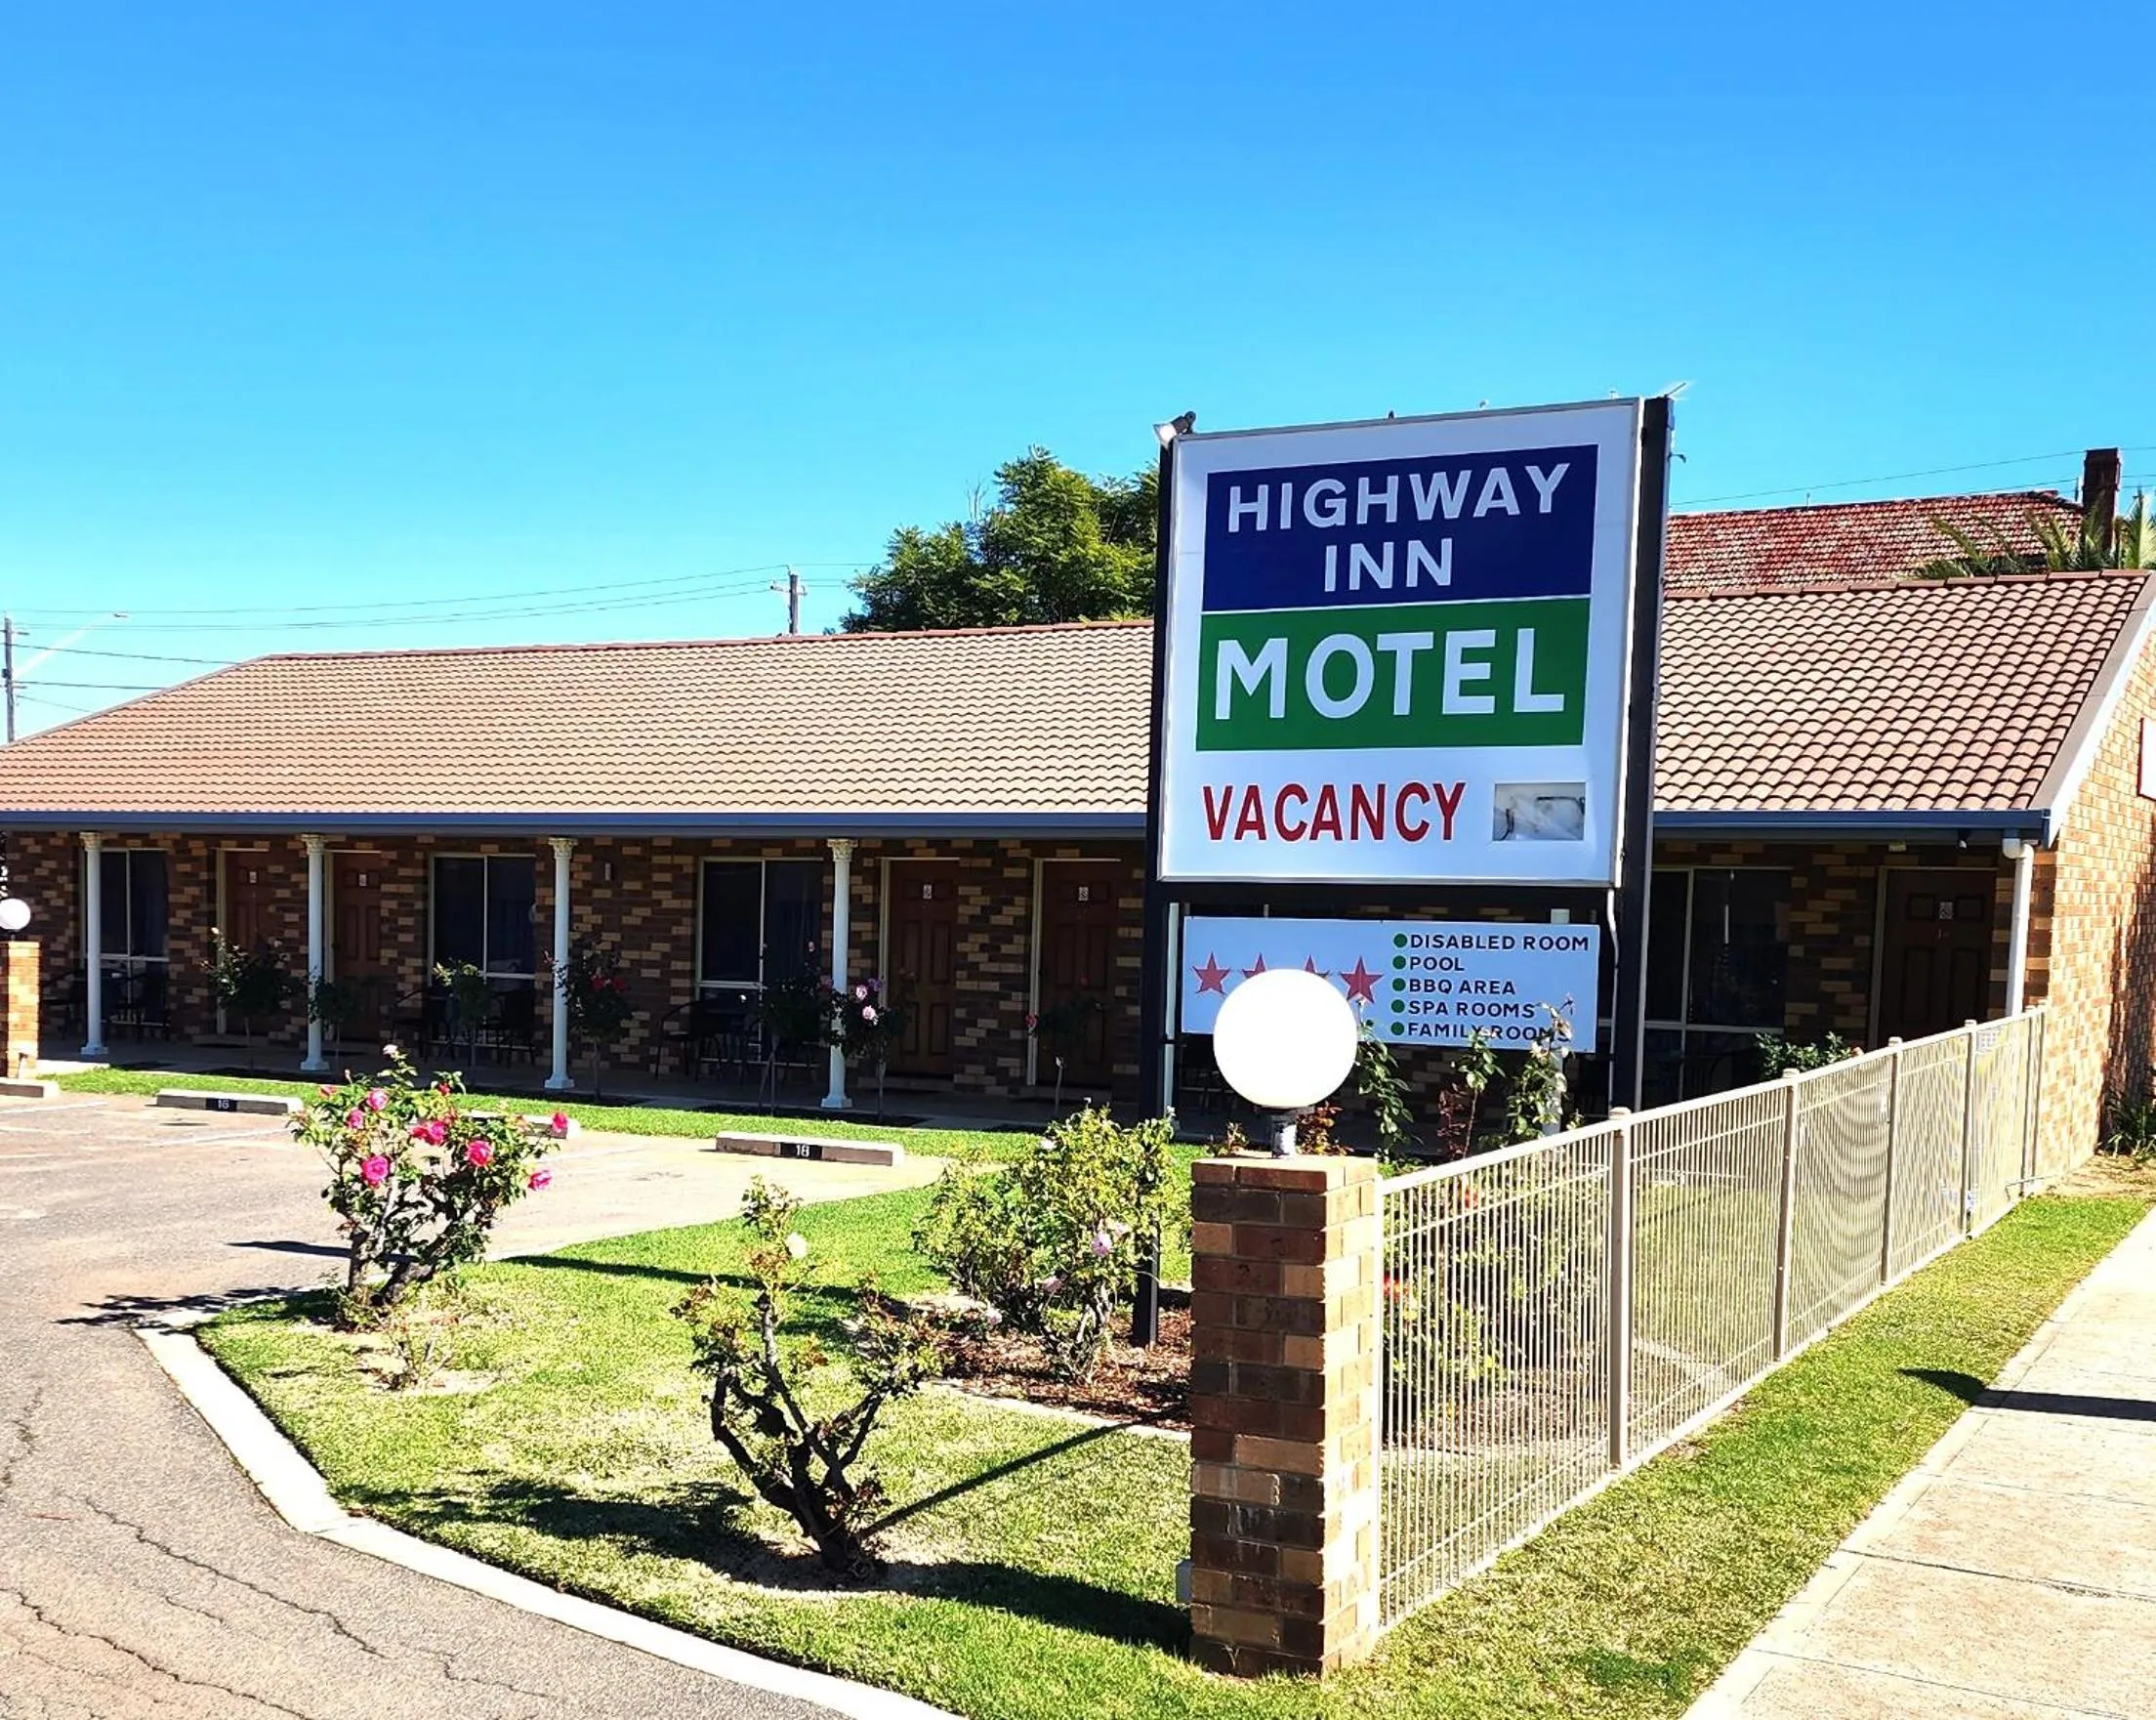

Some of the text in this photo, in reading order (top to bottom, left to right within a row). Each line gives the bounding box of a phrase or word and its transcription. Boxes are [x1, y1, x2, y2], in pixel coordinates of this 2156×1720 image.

[1227, 462, 1570, 532] HIGHWAY
[1324, 537, 1453, 592] INN
[1215, 627, 1564, 720] MOTEL
[1202, 782, 1466, 842] VACANCY
[1410, 934, 1589, 951] DISABLED ROOM
[1410, 956, 1465, 972] POOL
[1409, 979, 1515, 995] BBQ AREA
[1408, 1000, 1535, 1018] SPA ROOMS
[796, 1144, 809, 1156] 18
